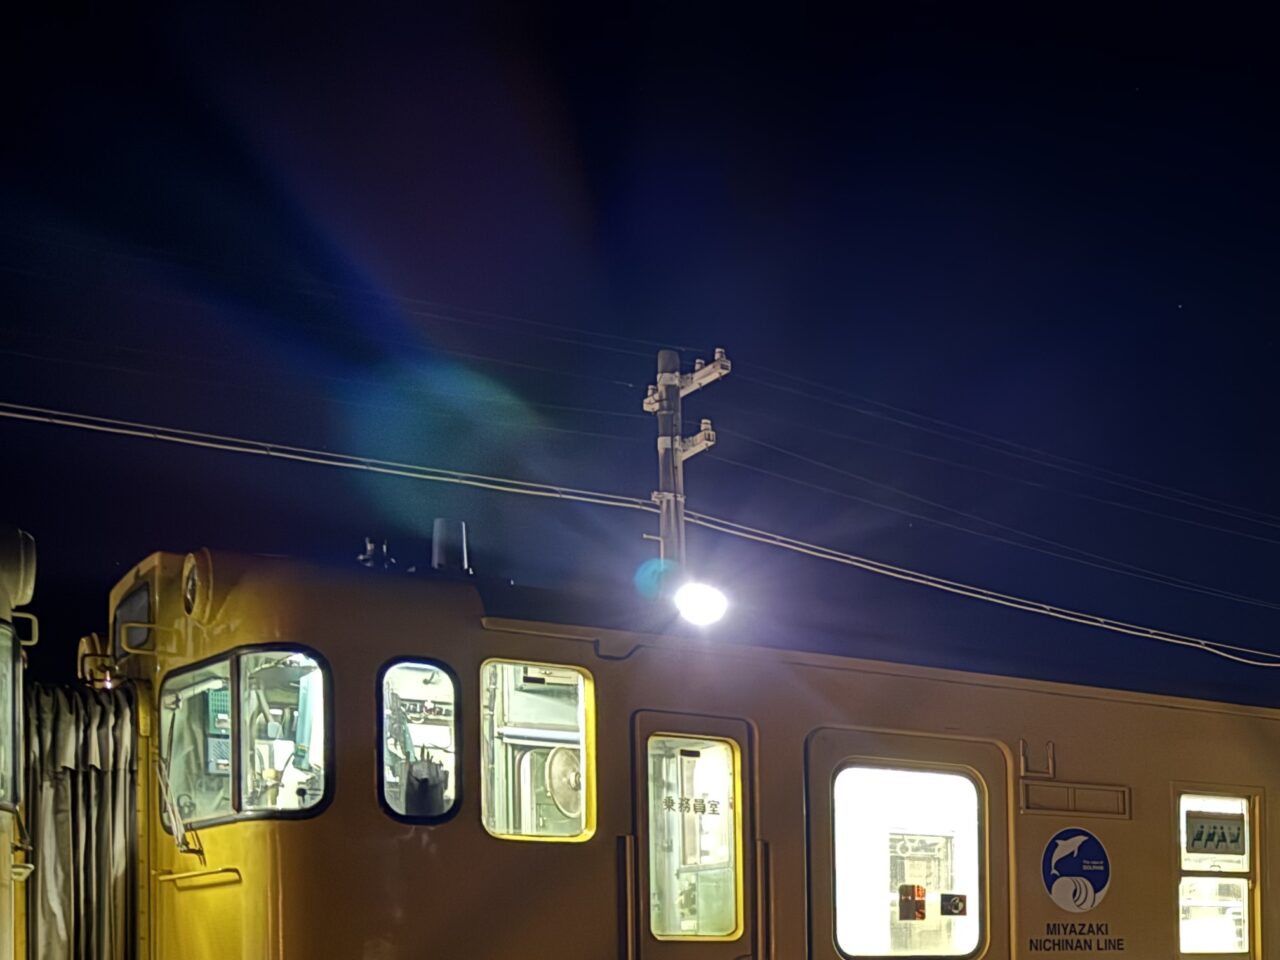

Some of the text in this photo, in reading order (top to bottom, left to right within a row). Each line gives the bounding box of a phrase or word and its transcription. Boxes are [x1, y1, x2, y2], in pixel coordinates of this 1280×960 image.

[663, 796, 720, 815] 乗務員室
[1046, 923, 1109, 935] MIYAZAKI
[1029, 939, 1125, 951] NICHINAN LINE
